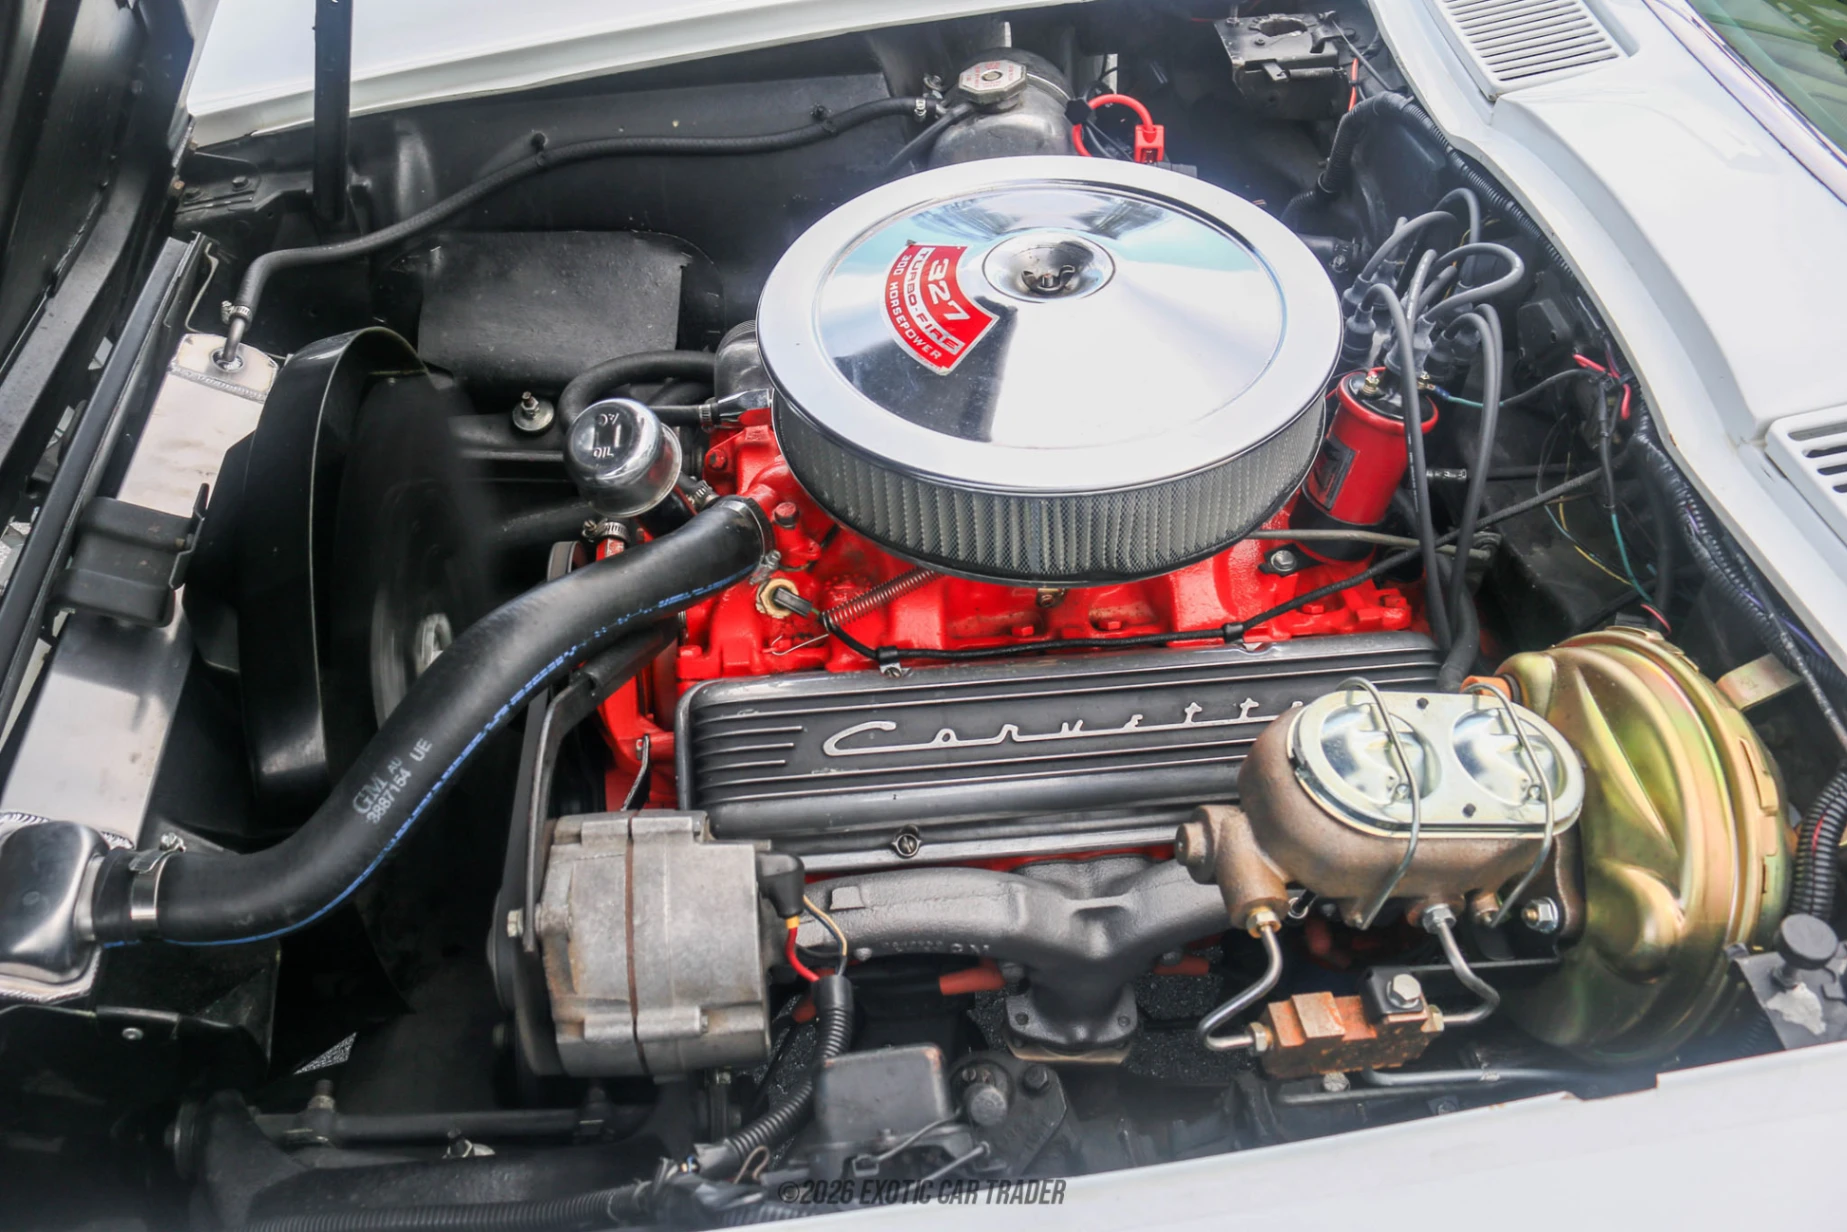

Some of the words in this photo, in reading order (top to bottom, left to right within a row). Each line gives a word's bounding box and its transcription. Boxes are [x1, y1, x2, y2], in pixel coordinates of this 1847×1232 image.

[893, 254, 912, 276] 300
[928, 257, 971, 321] 327
[889, 281, 942, 360] HORSEPOWER
[906, 250, 960, 351] TURBO-FIRE
[593, 446, 615, 459] OIL
[823, 696, 1304, 756] Corvett
[353, 773, 388, 814] GM
[366, 767, 412, 825] 3887154
[410, 738, 433, 762] UE
